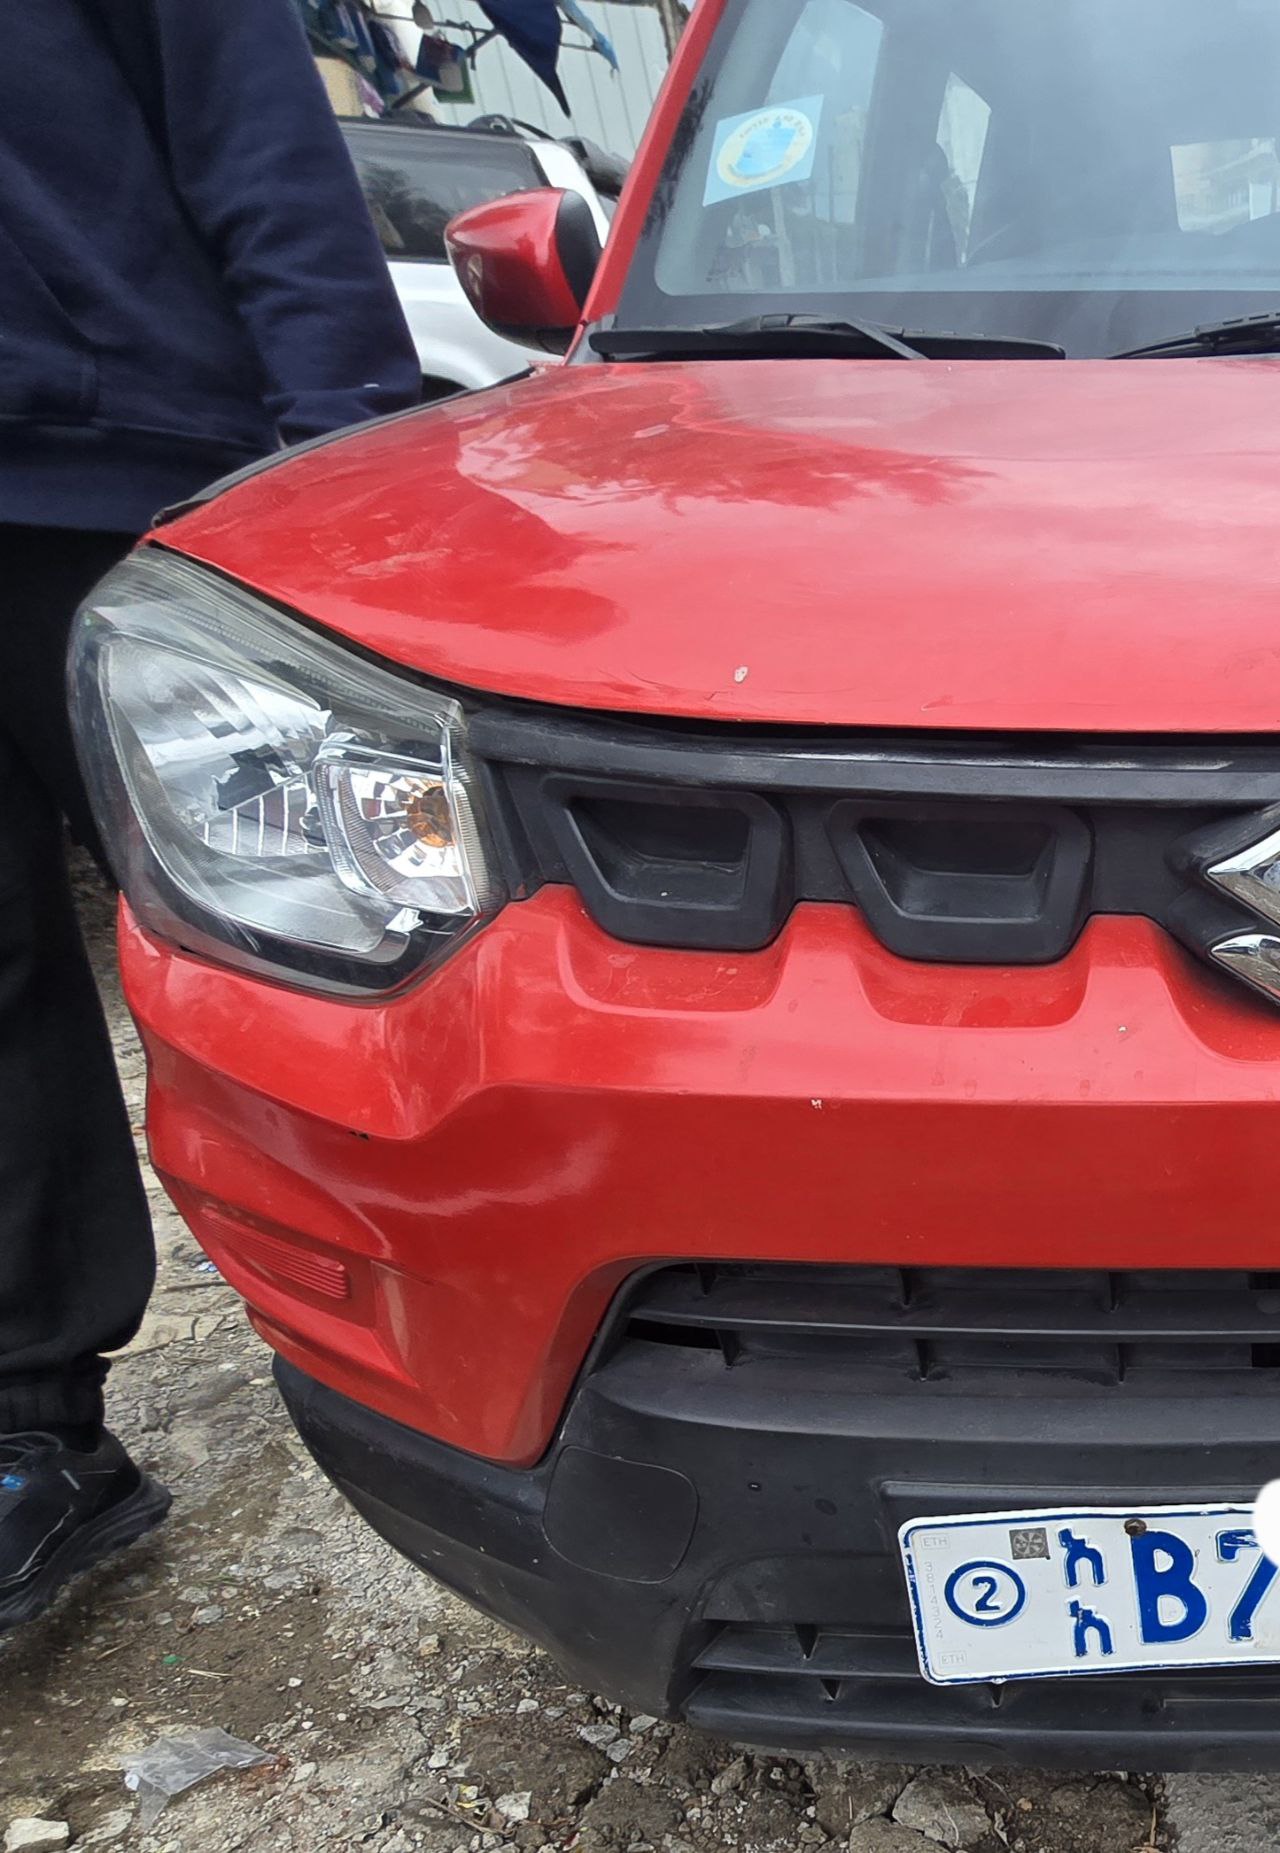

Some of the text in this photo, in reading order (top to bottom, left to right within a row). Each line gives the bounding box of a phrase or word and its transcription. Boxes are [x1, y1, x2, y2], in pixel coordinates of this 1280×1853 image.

[922, 1536, 948, 1547] ETH
[971, 1576, 1001, 1612] 2
[941, 1654, 965, 1665] ETH
